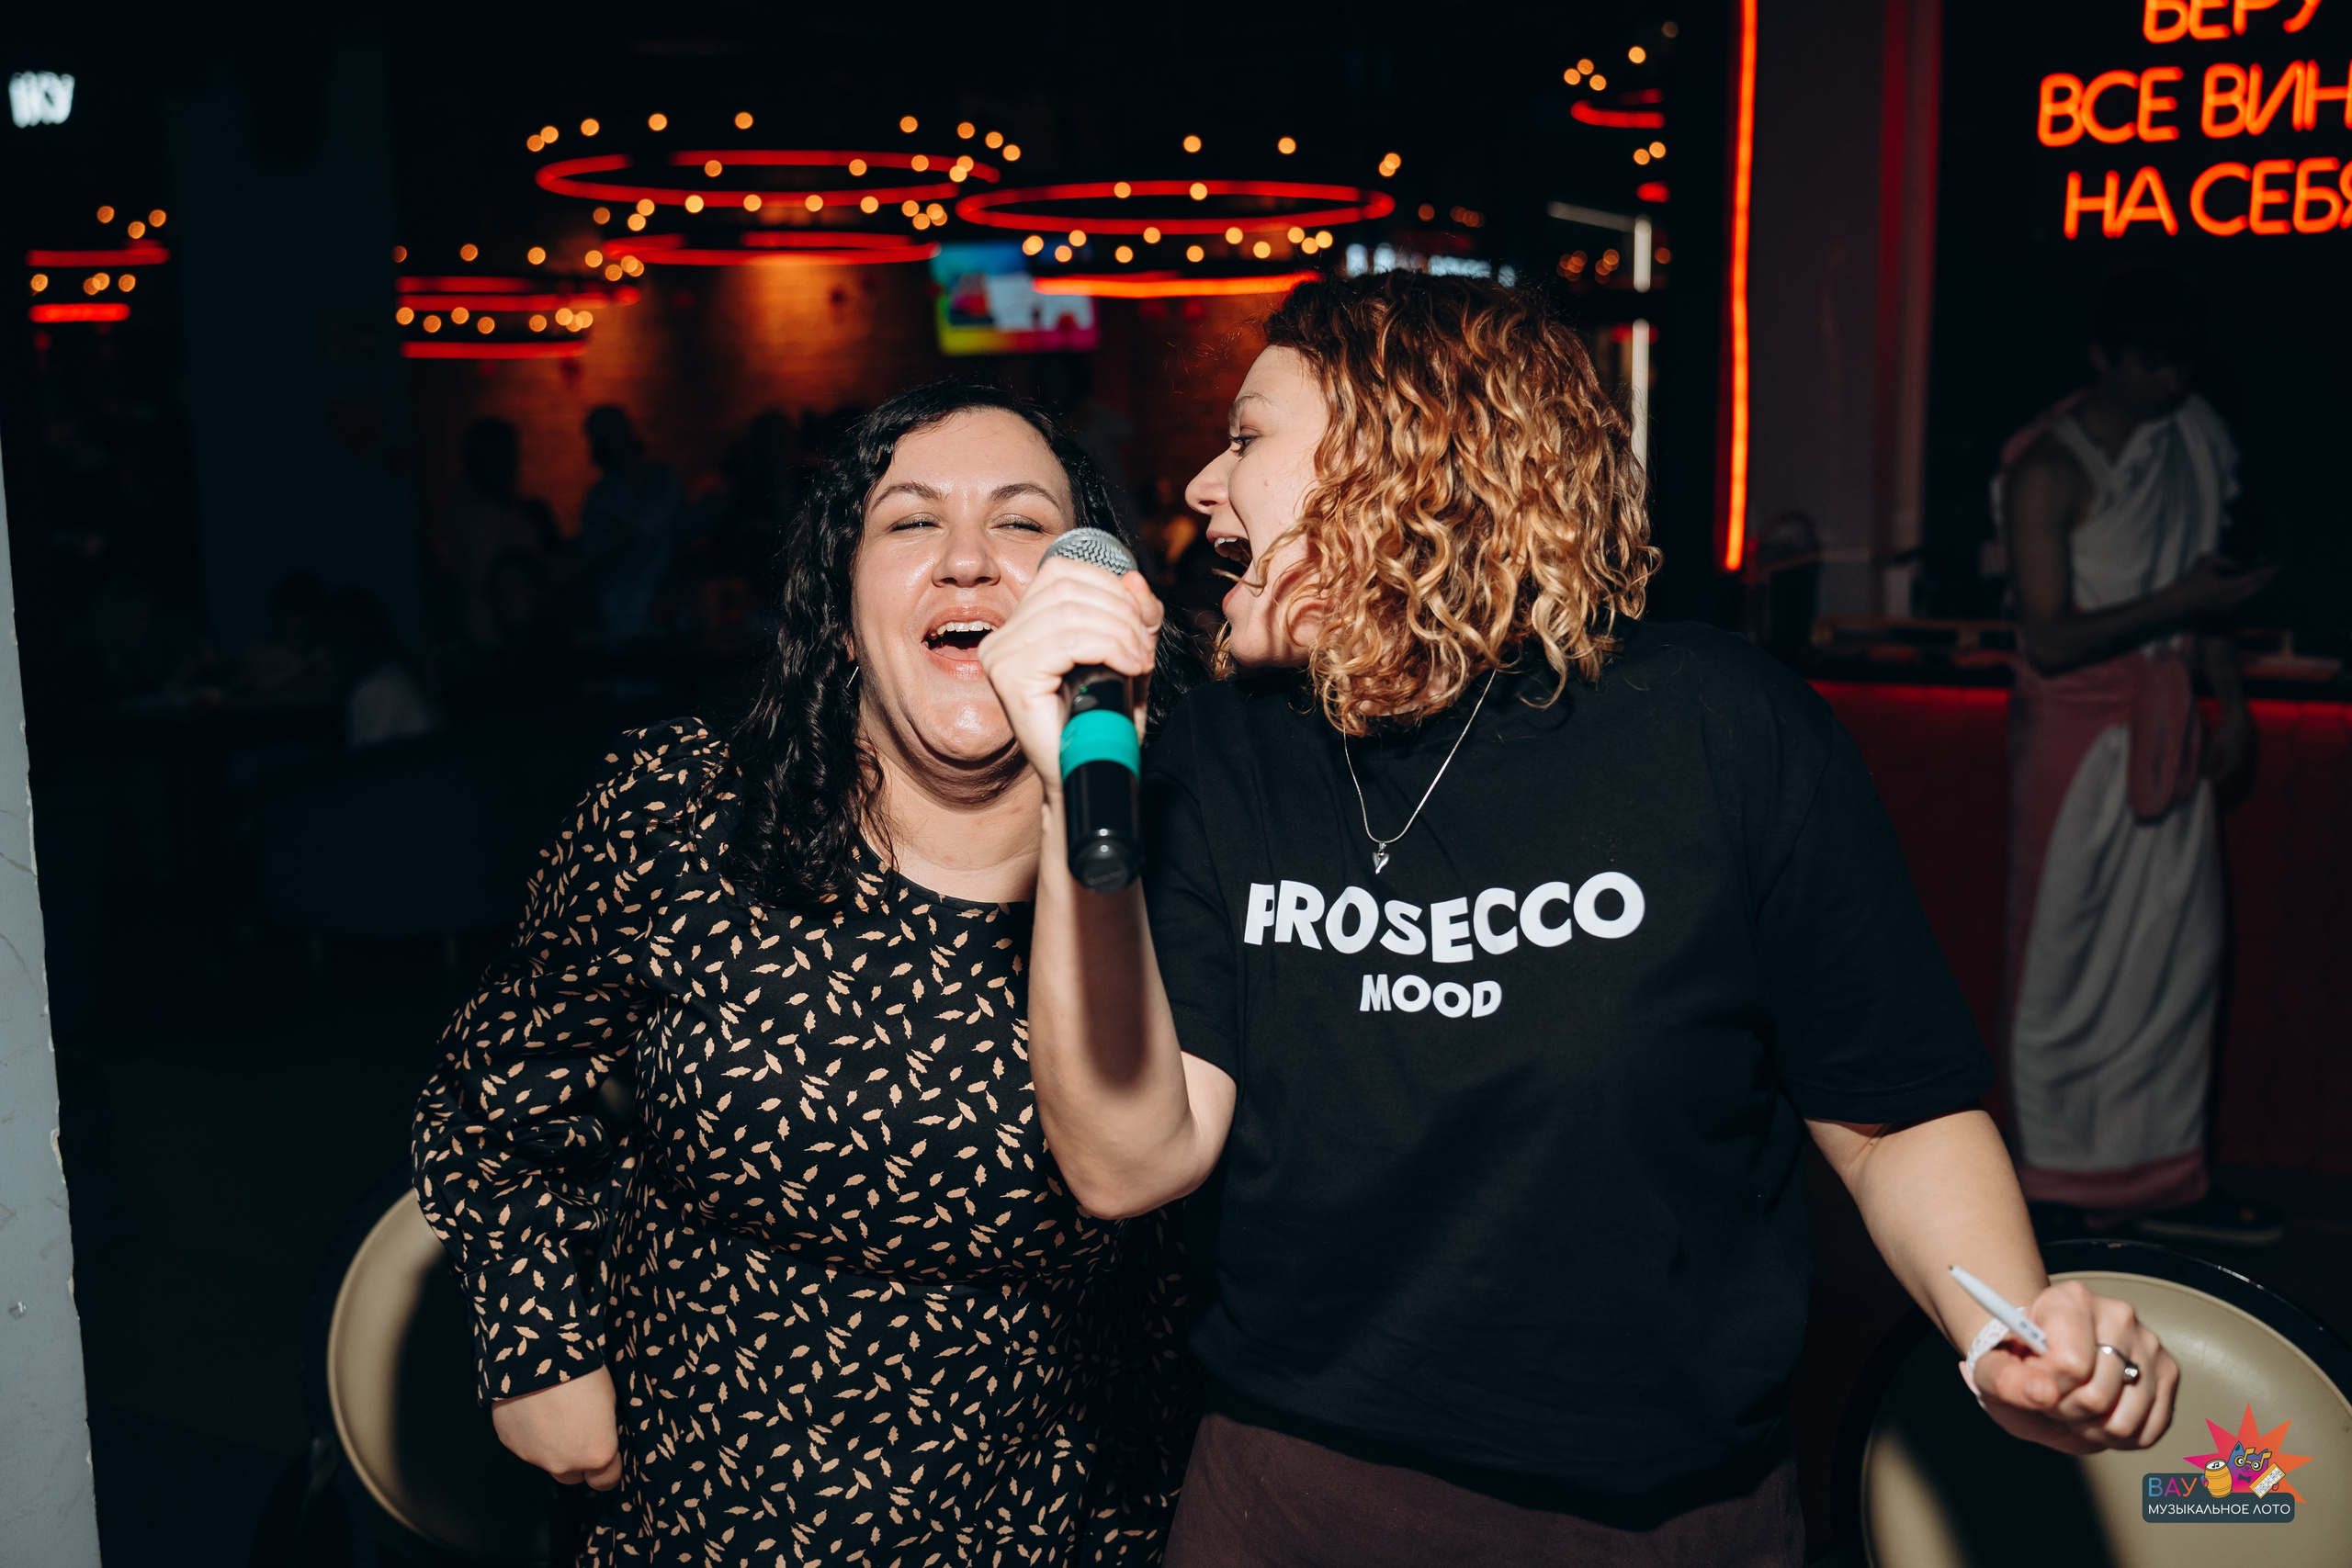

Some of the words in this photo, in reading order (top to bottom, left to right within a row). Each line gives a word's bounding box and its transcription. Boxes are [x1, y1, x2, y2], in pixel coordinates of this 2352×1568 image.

[2037, 66, 2185, 147] ВСЕ
[2064, 165, 2178, 241] НА
[2189, 157, 2352, 237] СЕБ
[1244, 871, 1645, 964] PROSECCO
[1360, 973, 1503, 1019] MOOD
